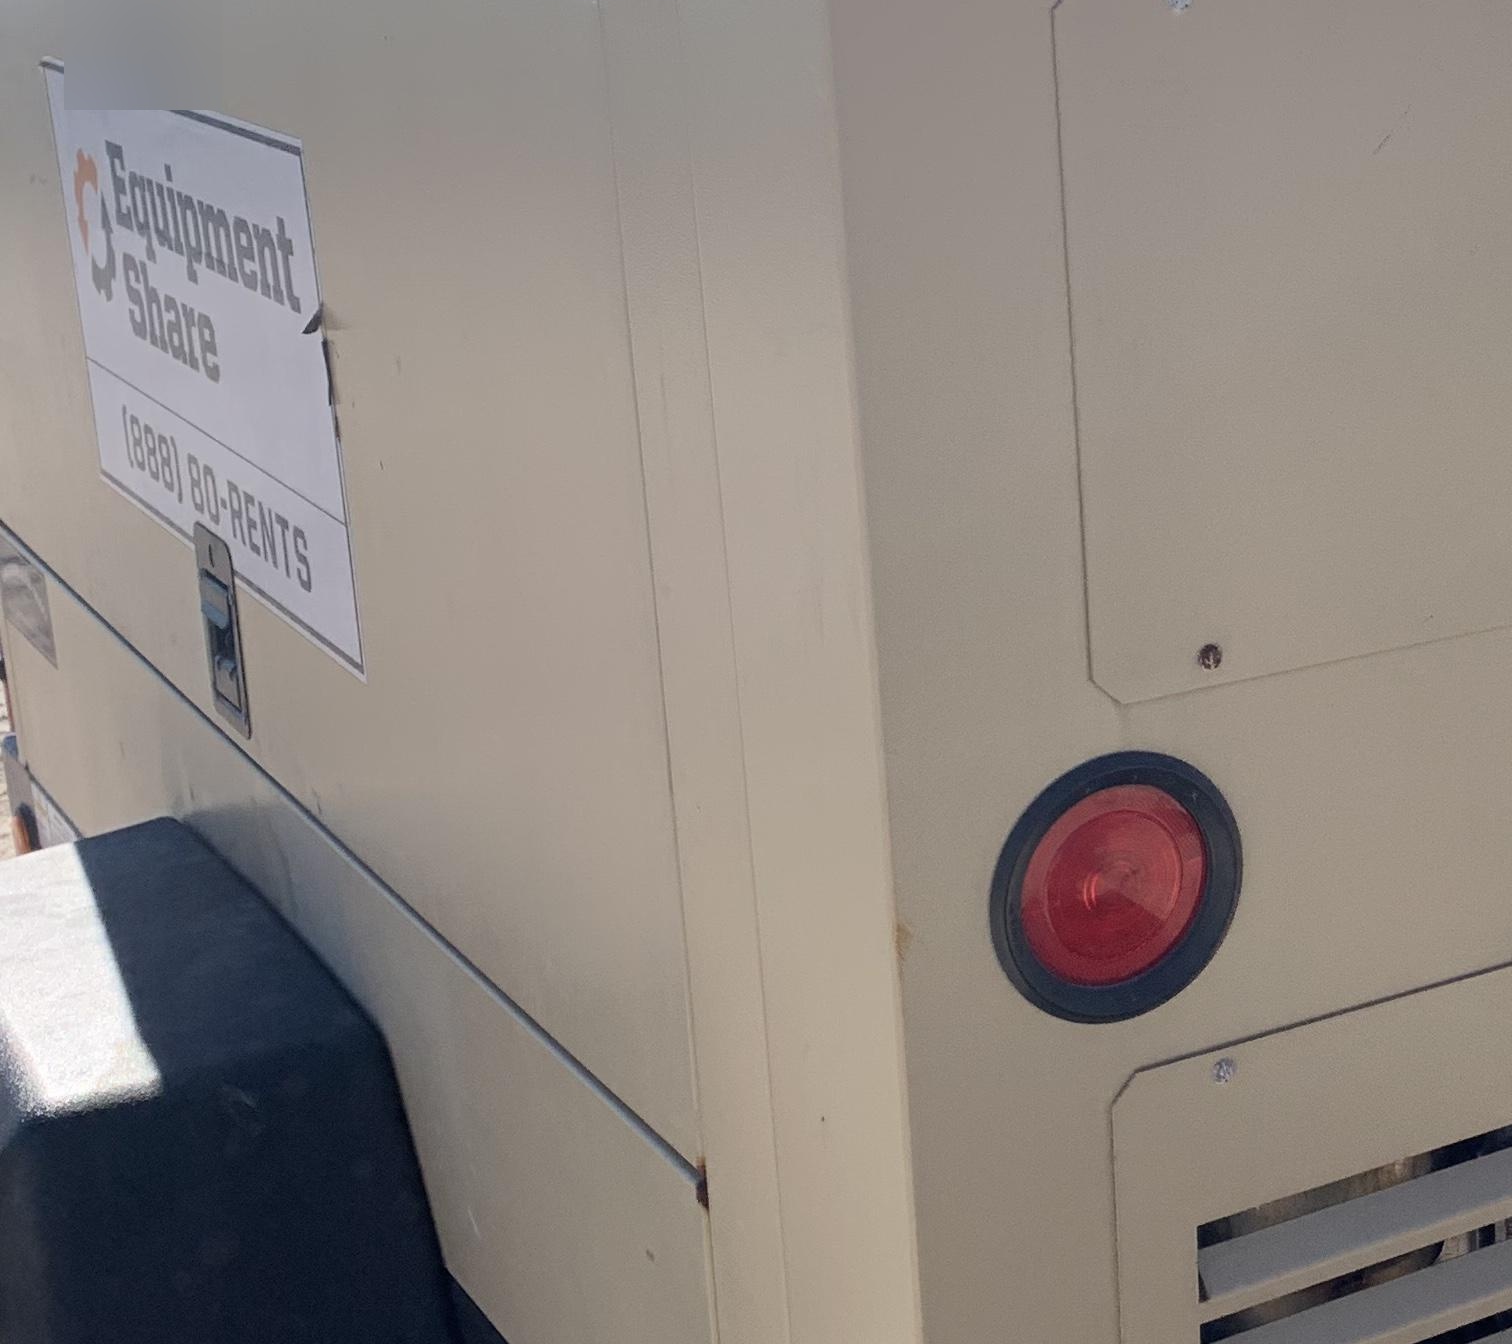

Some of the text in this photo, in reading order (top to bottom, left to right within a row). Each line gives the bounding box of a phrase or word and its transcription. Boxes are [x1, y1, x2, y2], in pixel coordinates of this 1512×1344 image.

[105, 139, 301, 314] Equipment
[122, 251, 220, 384] Share
[122, 405, 312, 593] (888) 80-RENTS
